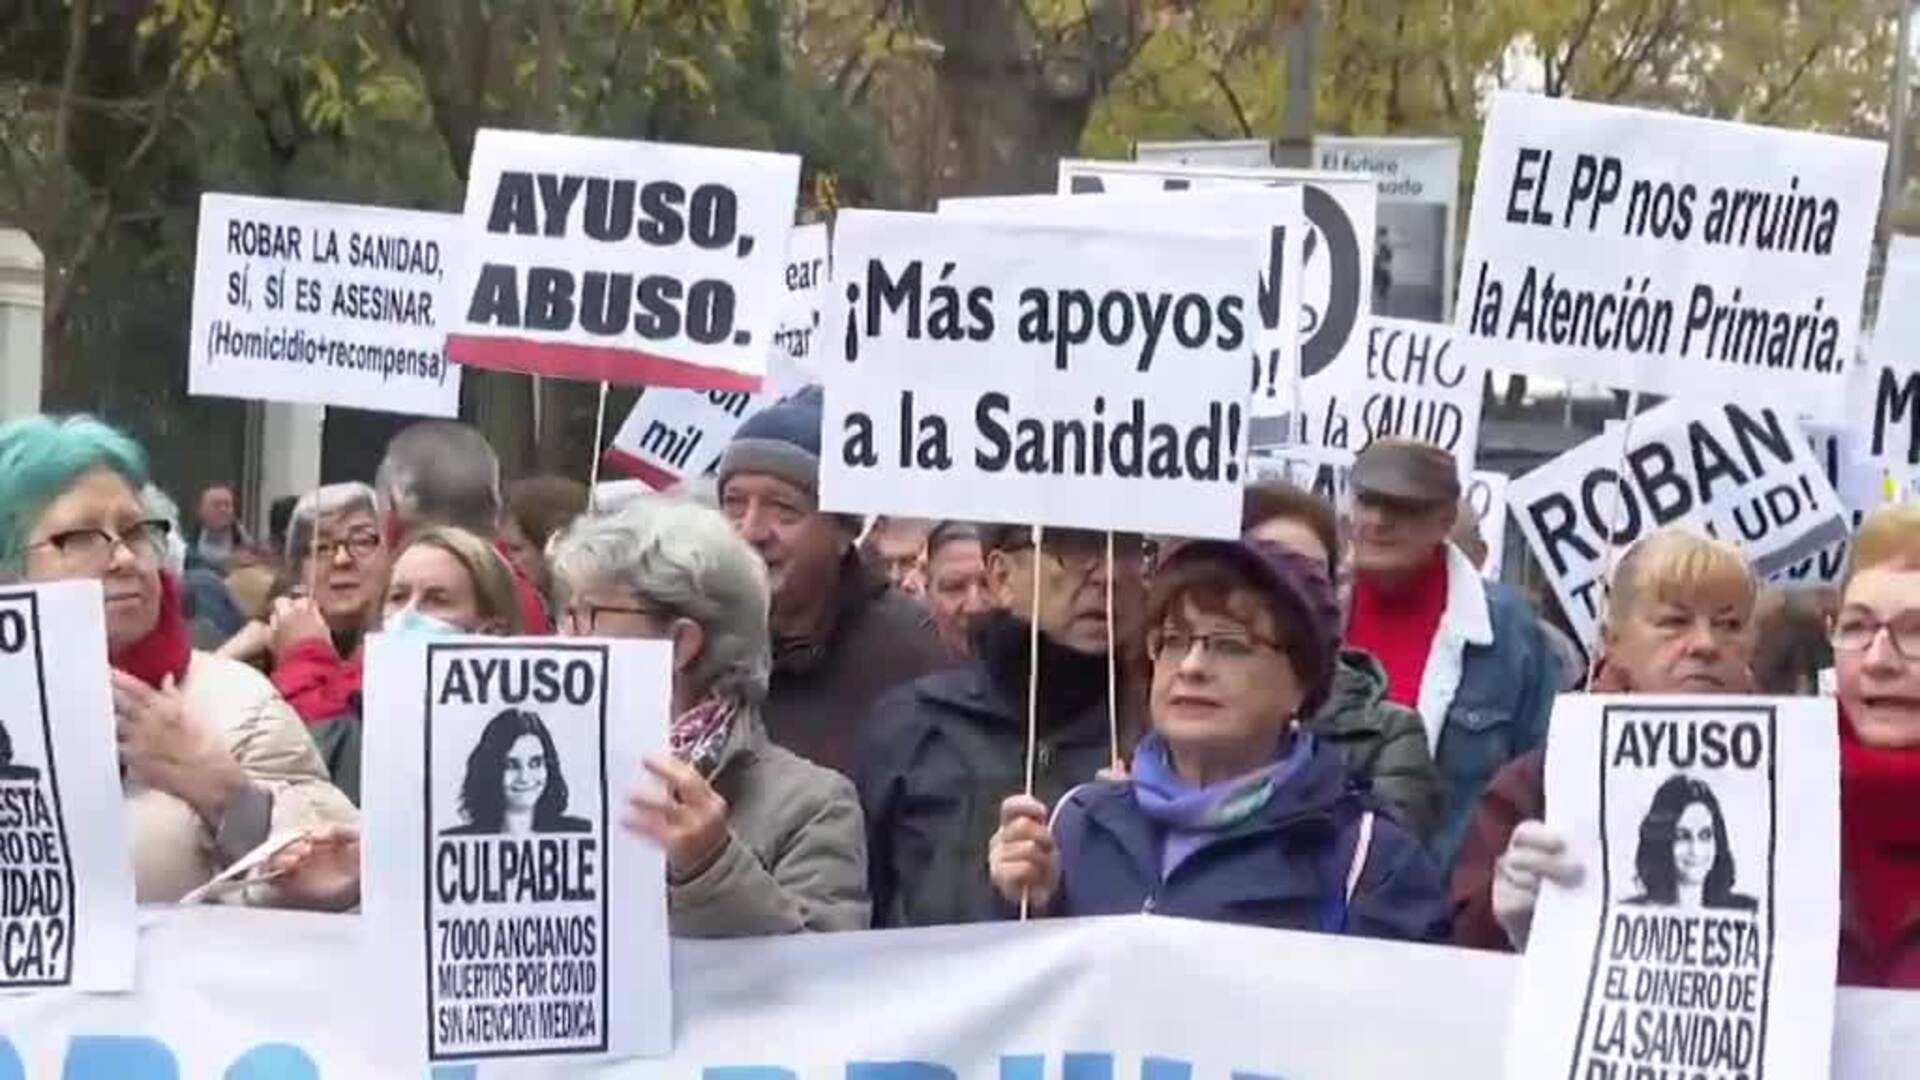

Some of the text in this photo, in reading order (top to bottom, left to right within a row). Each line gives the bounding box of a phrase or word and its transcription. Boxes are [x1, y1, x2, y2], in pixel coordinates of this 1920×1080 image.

[487, 171, 754, 258] AYUSO,
[1506, 147, 1839, 255] EL PP nos arruina
[227, 219, 444, 283] ROBAR LA SANIDAD,
[227, 263, 435, 326] SÍ, SÍ ES ASESINAR.
[466, 262, 751, 345] ABUSO.
[845, 259, 995, 362] ¡Más
[1018, 285, 1244, 371] apoyos
[1470, 261, 1844, 375] la Atención Primaria.
[640, 420, 703, 469] mil
[843, 412, 877, 467] a
[900, 390, 952, 470] la
[974, 392, 1241, 483] Sanidad!
[1527, 403, 1795, 577] ROBAN
[438, 659, 595, 705] AYUSO
[1613, 721, 1763, 769] AYUSO
[27, 832, 60, 864] DE
[437, 839, 597, 904] CULPABLE
[438, 916, 596, 961] 7000 ANCIANOS
[1610, 913, 1760, 968] DONDE ESTA
[438, 960, 597, 999] MUERTOS POR COVID
[1604, 965, 1758, 1013] EL DINERO DE
[438, 999, 597, 1044] SIN ATENCION MEDICA
[1593, 1003, 1753, 1071] LA SANIDAD
